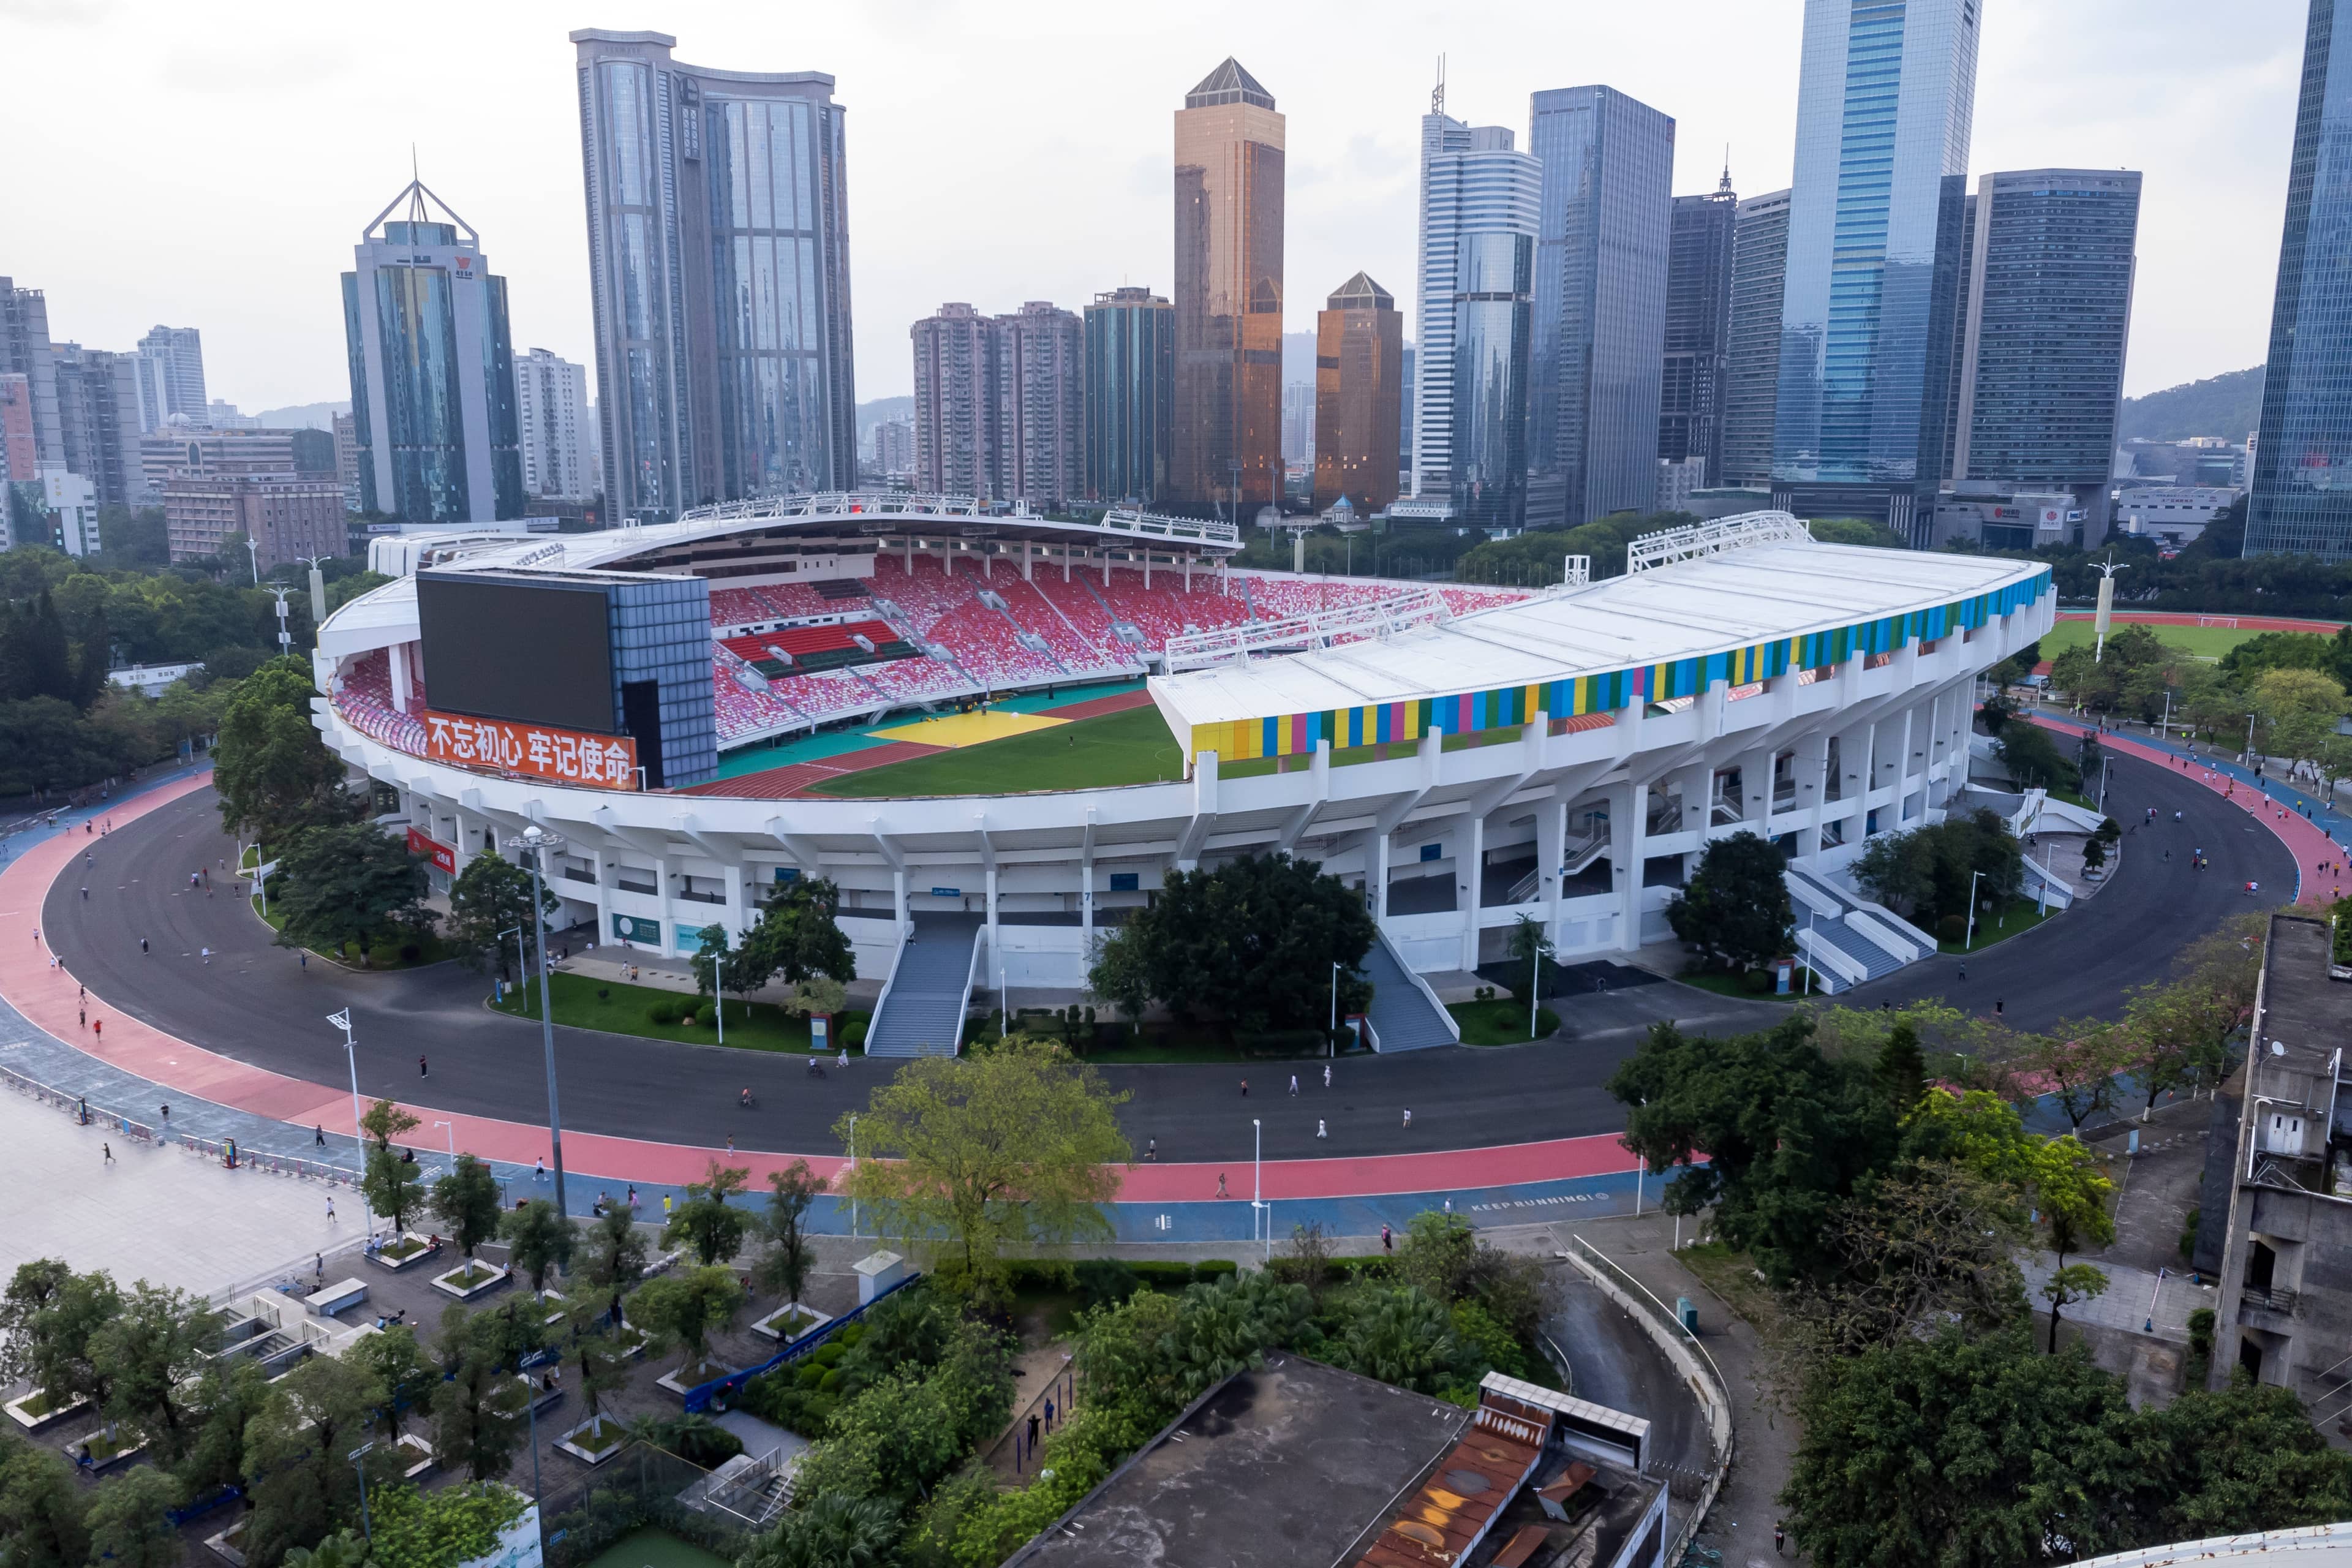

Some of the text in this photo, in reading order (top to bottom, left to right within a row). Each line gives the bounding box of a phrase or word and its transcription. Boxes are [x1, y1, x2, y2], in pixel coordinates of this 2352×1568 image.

[428, 717, 630, 785] 不忘初心 牢记使命
[1085, 892, 1091, 901] 7
[1471, 1202, 1510, 1212] KEEP
